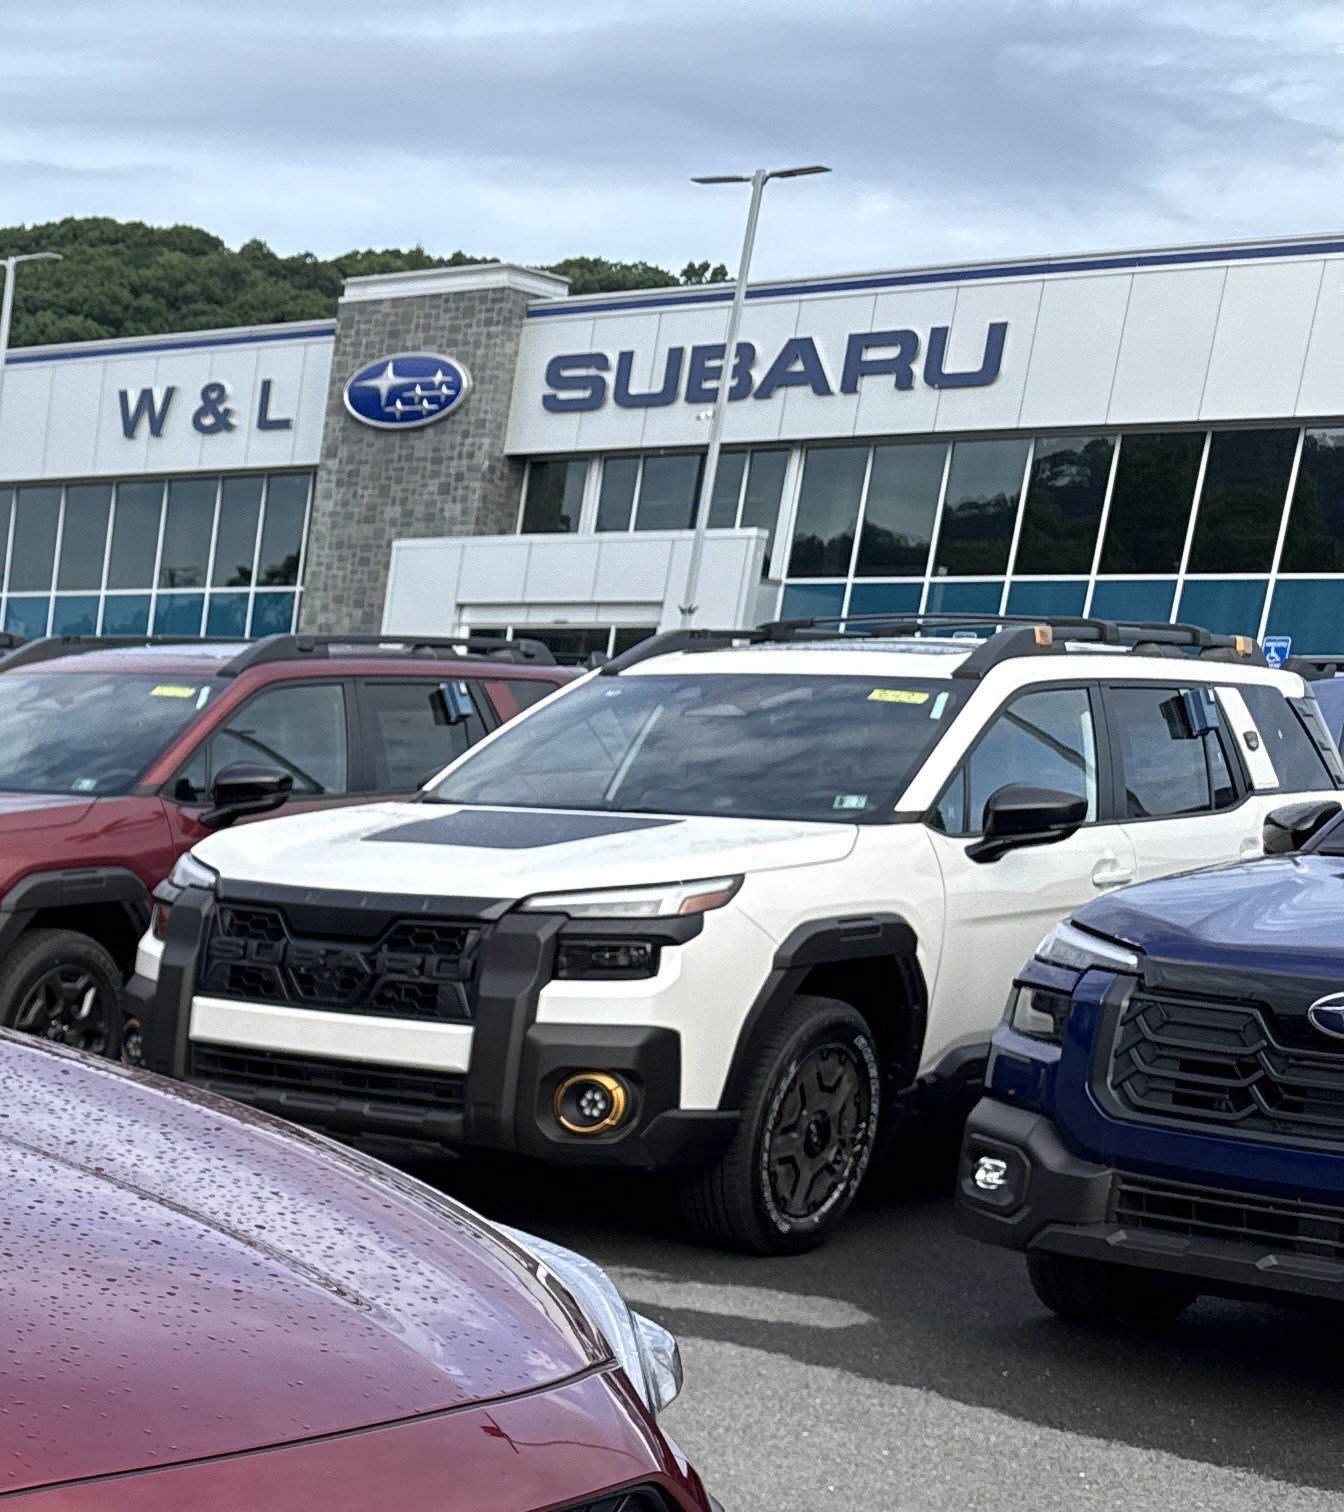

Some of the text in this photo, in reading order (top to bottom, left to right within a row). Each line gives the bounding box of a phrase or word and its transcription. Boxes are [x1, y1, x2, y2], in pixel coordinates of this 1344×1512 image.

[542, 322, 1010, 415] SUBARU
[119, 379, 293, 440] W & L
